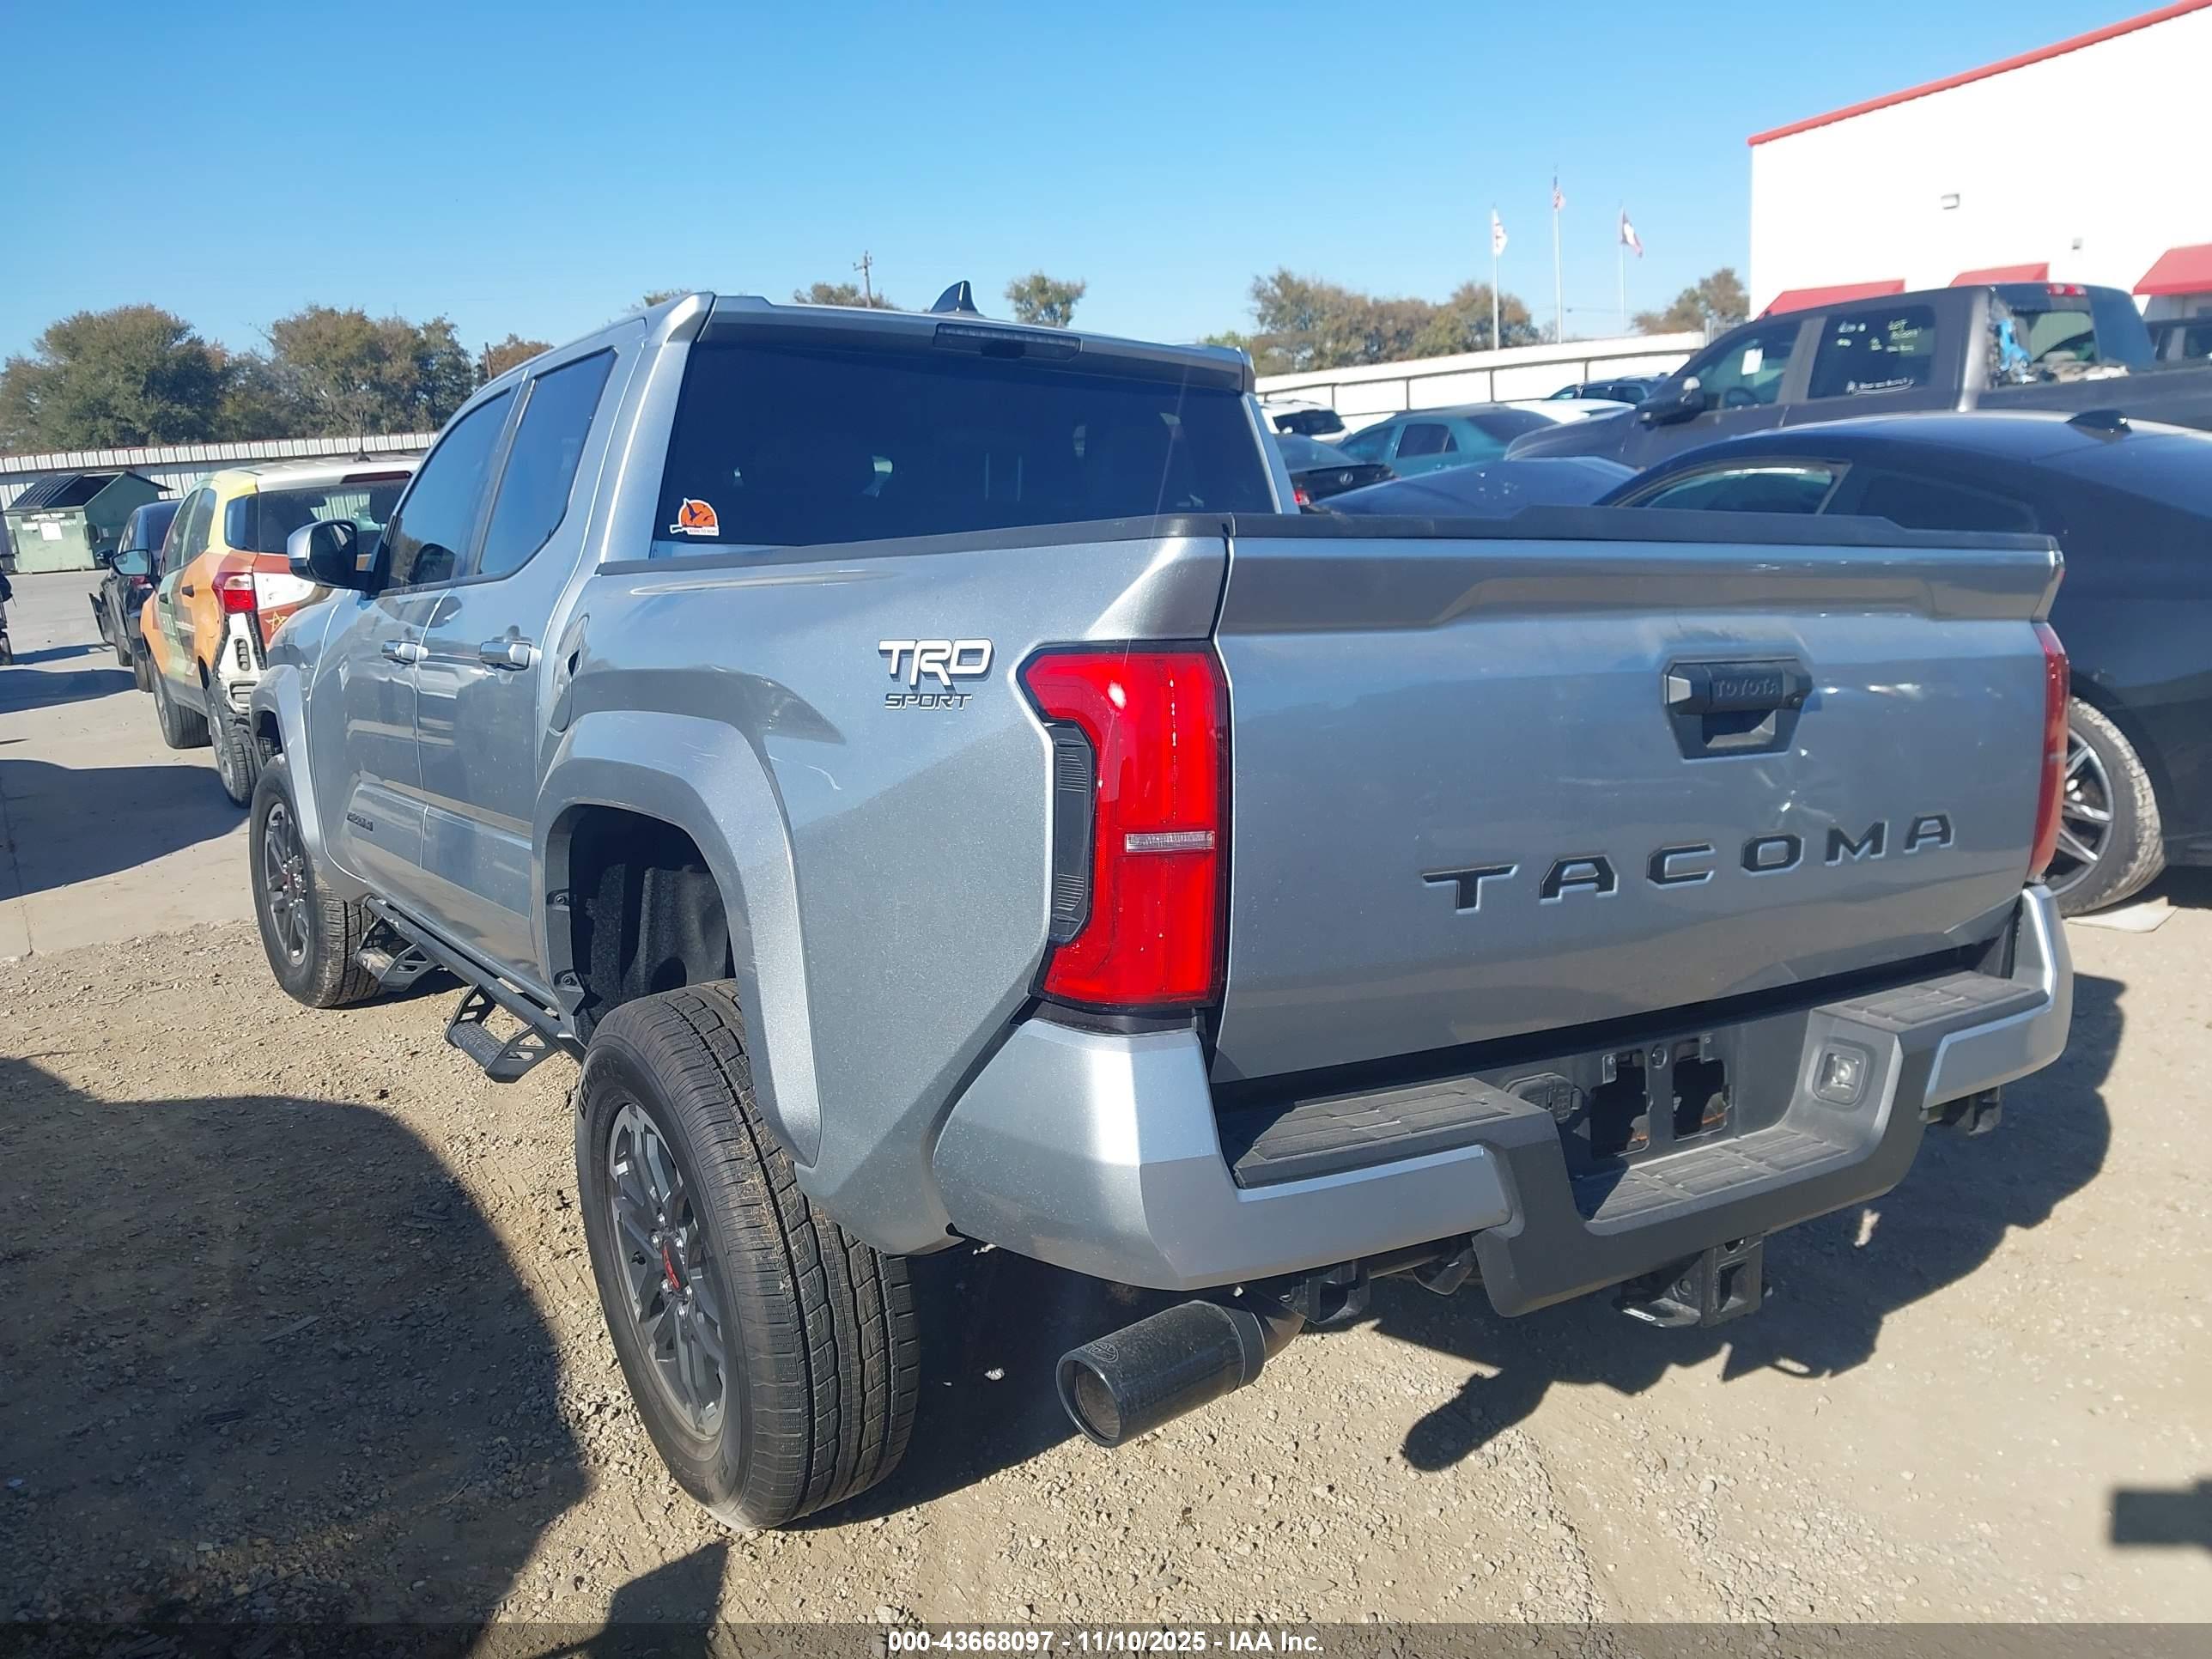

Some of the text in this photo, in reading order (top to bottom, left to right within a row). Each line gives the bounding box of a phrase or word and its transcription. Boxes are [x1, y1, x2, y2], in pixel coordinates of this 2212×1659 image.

[878, 639, 994, 687] TRD
[884, 693, 973, 710] SPORT
[1421, 812, 1954, 914] TACOMA
